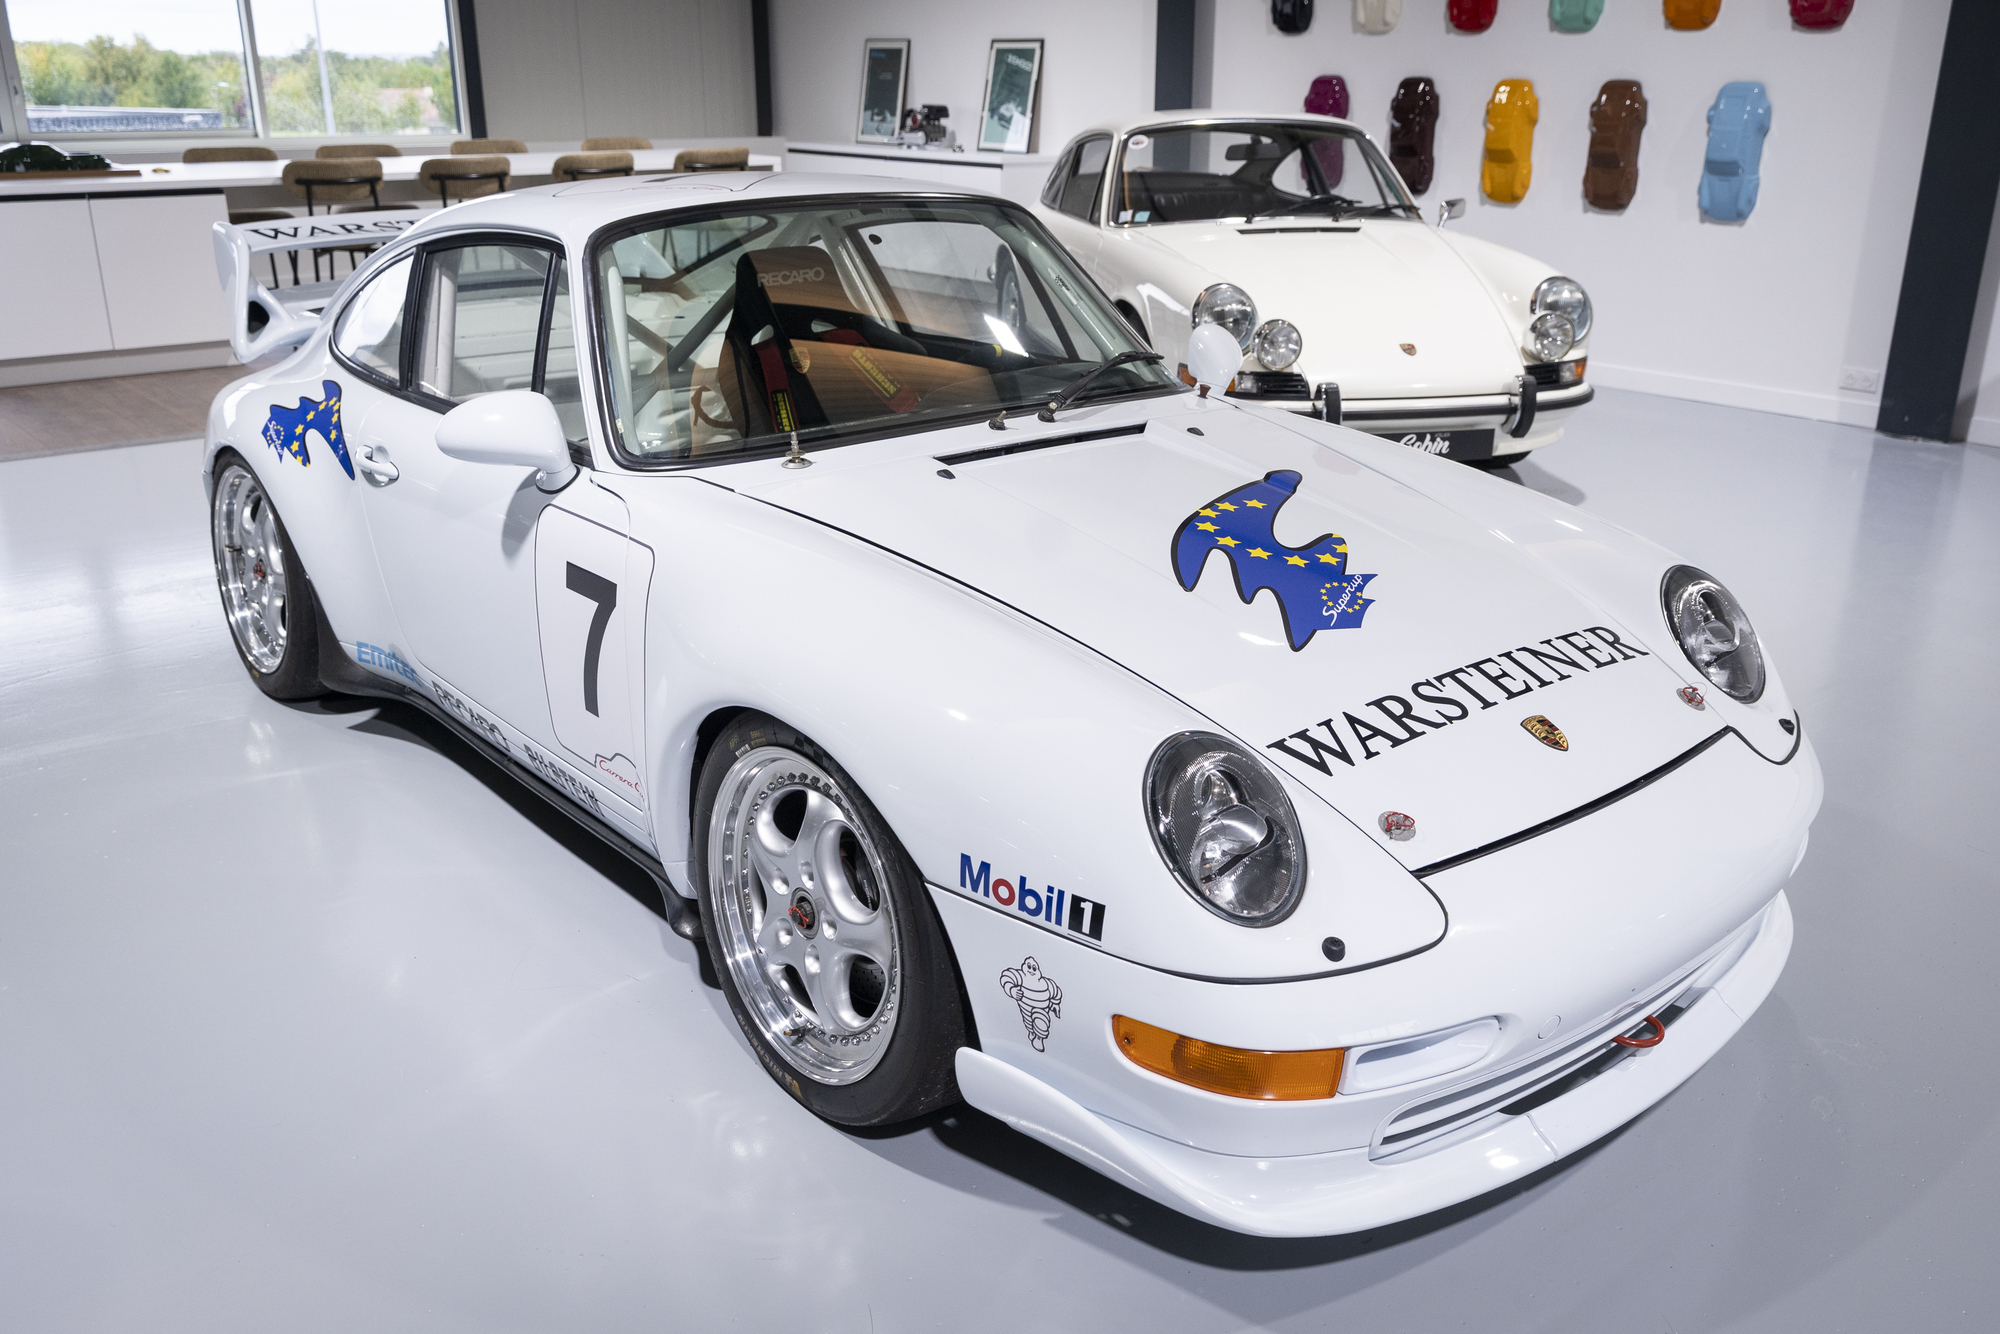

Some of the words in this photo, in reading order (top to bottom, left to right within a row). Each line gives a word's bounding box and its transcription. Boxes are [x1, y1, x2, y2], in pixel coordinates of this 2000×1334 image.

[757, 267, 825, 288] RECARO
[1322, 574, 1364, 627] Supercup
[566, 560, 618, 718] 7
[431, 680, 511, 752] RECARO
[1266, 626, 1650, 777] WARSTEINER
[523, 743, 605, 818] BILSTEIN
[598, 760, 634, 789] Carrera
[960, 852, 1065, 927] Mobil
